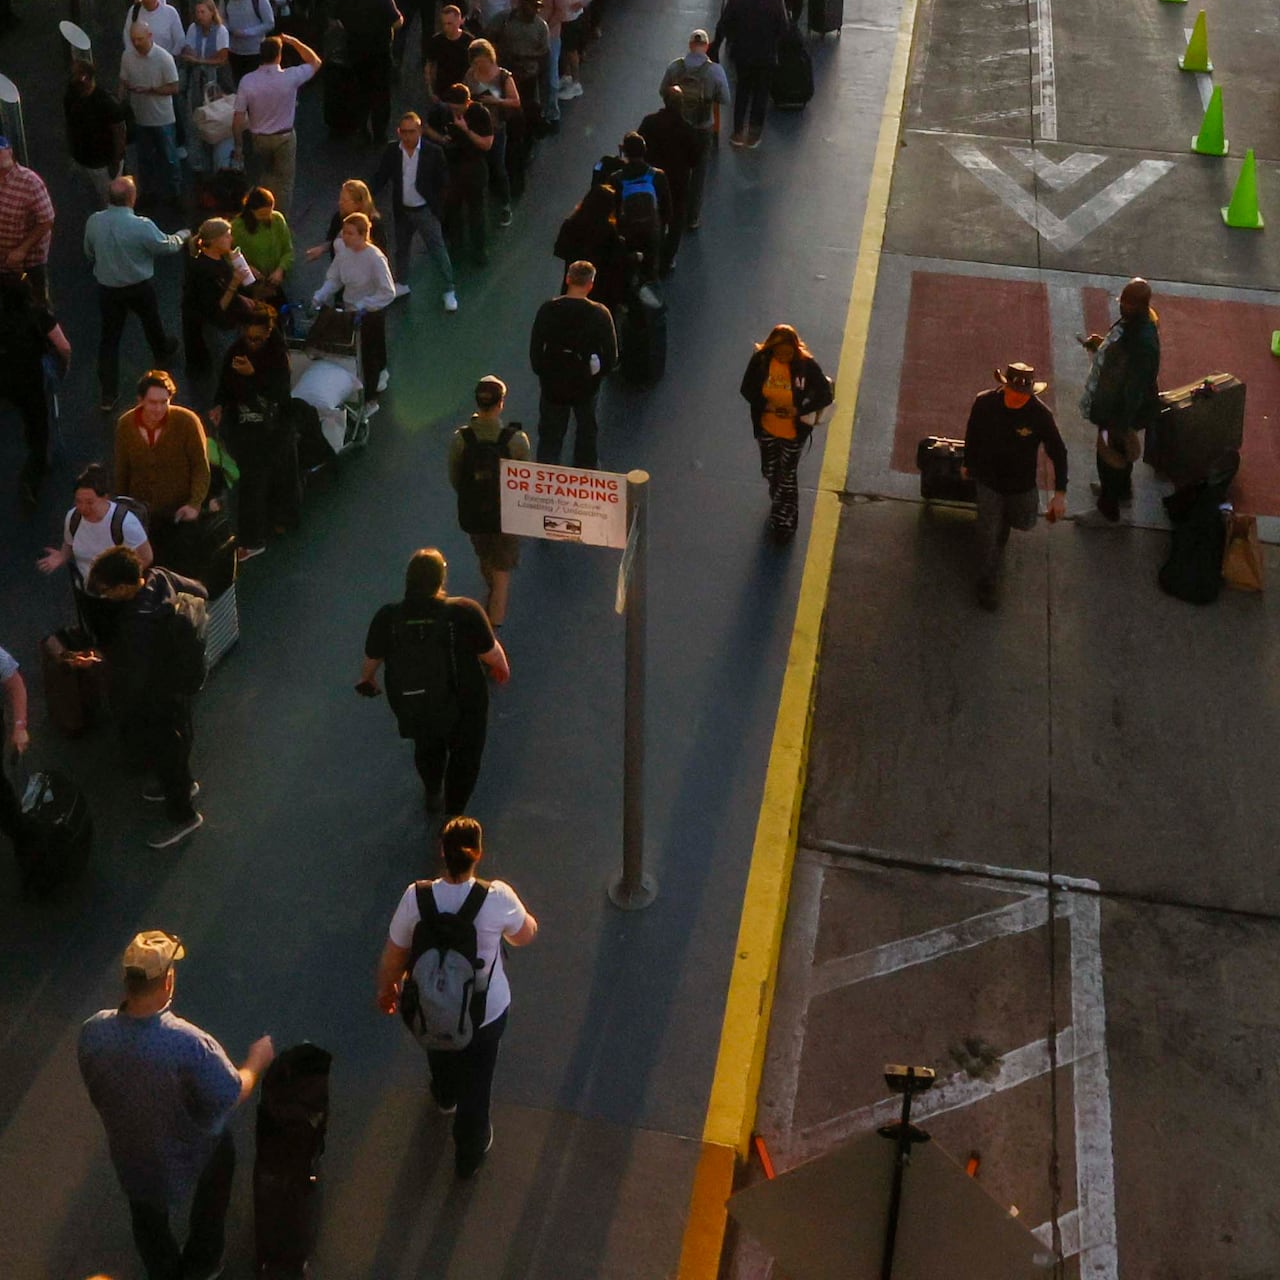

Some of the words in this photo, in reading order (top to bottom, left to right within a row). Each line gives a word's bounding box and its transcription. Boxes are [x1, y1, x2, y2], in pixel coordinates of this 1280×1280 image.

[507, 466, 531, 479] NO
[536, 470, 618, 491] STOPPING
[506, 479, 529, 491] OR
[535, 483, 619, 504] STANDING
